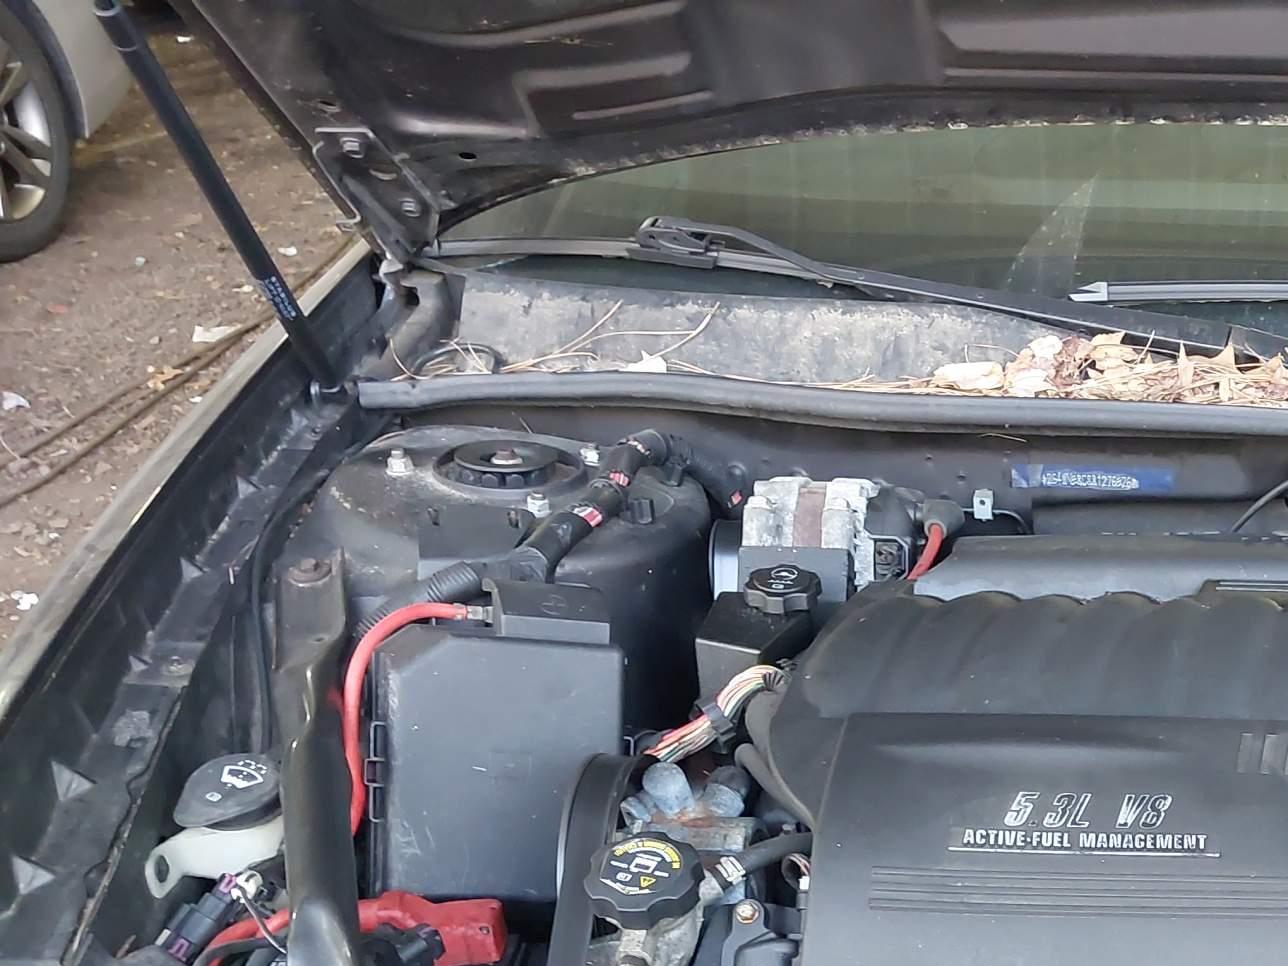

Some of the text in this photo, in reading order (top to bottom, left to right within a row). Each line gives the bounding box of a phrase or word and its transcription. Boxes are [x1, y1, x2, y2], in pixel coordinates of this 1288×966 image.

[1003, 791, 1172, 829] 5.3L V8
[1079, 832, 1207, 850] MANAGEMENT
